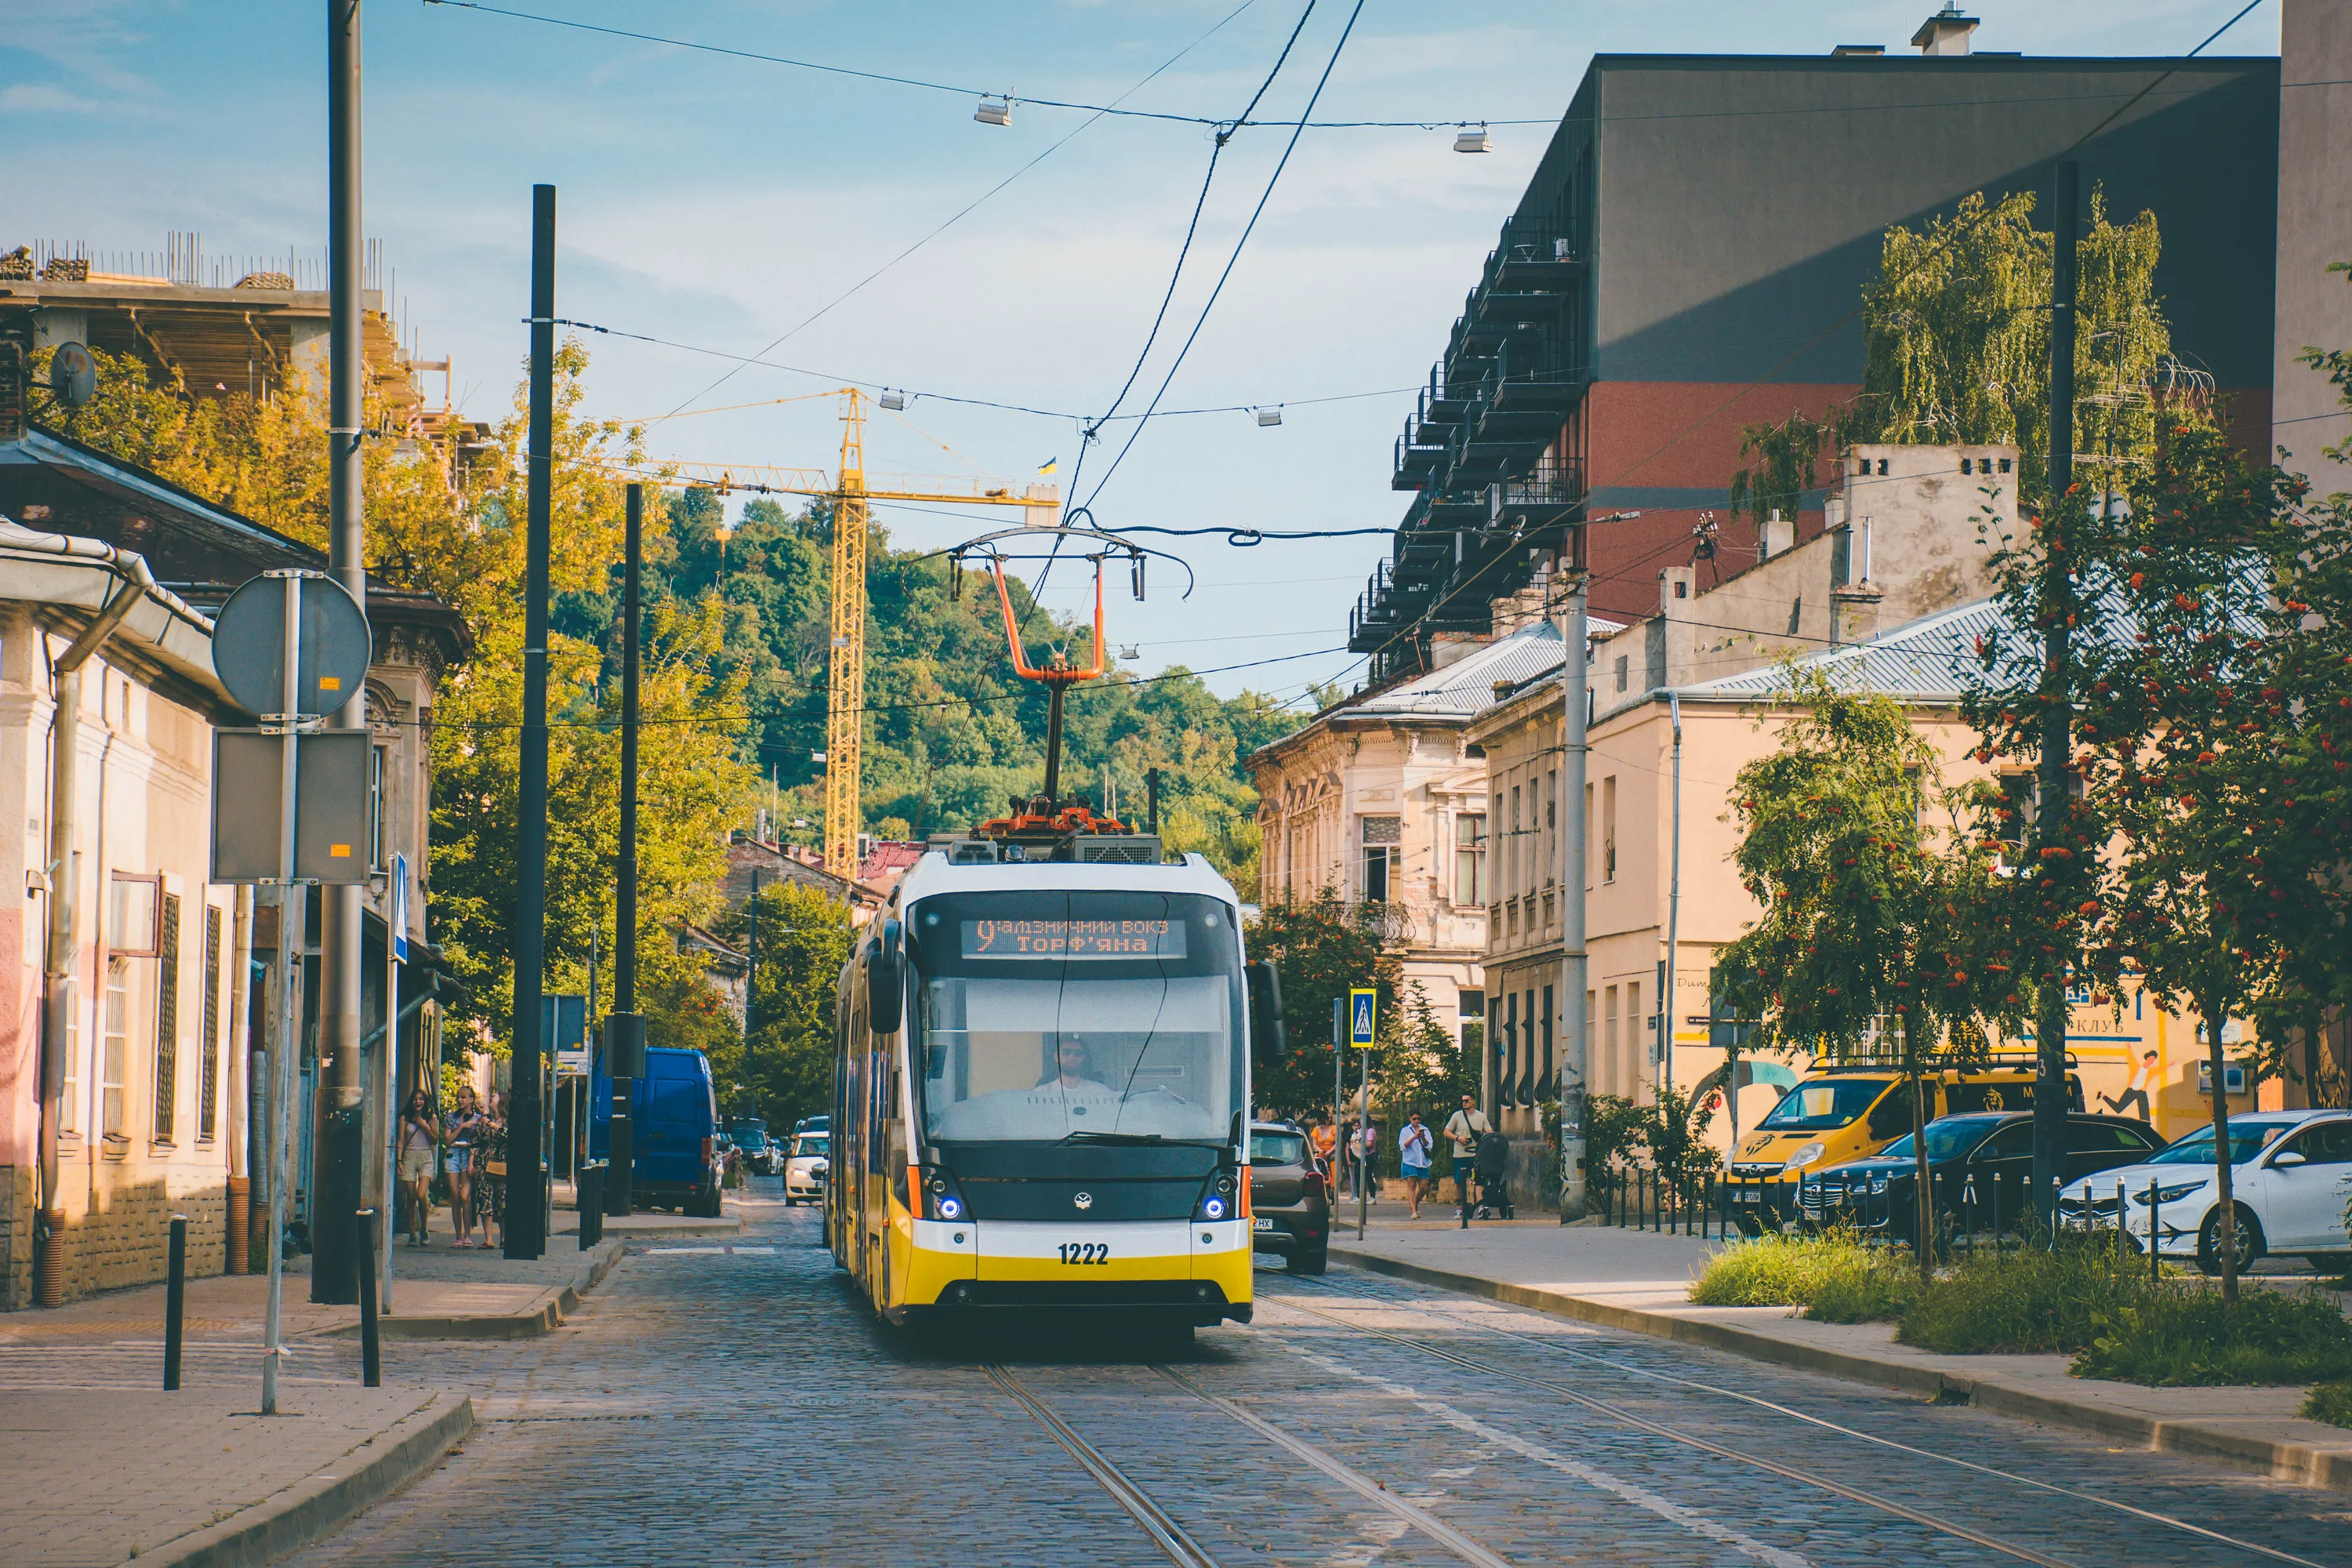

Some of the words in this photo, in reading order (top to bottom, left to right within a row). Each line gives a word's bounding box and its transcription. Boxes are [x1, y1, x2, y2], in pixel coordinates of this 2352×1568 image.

[977, 920, 995, 952] 9
[1017, 936, 1147, 952] Торф'яна
[2077, 1019, 2124, 1033] КЛУБ
[1058, 1243, 1109, 1265] 1222
